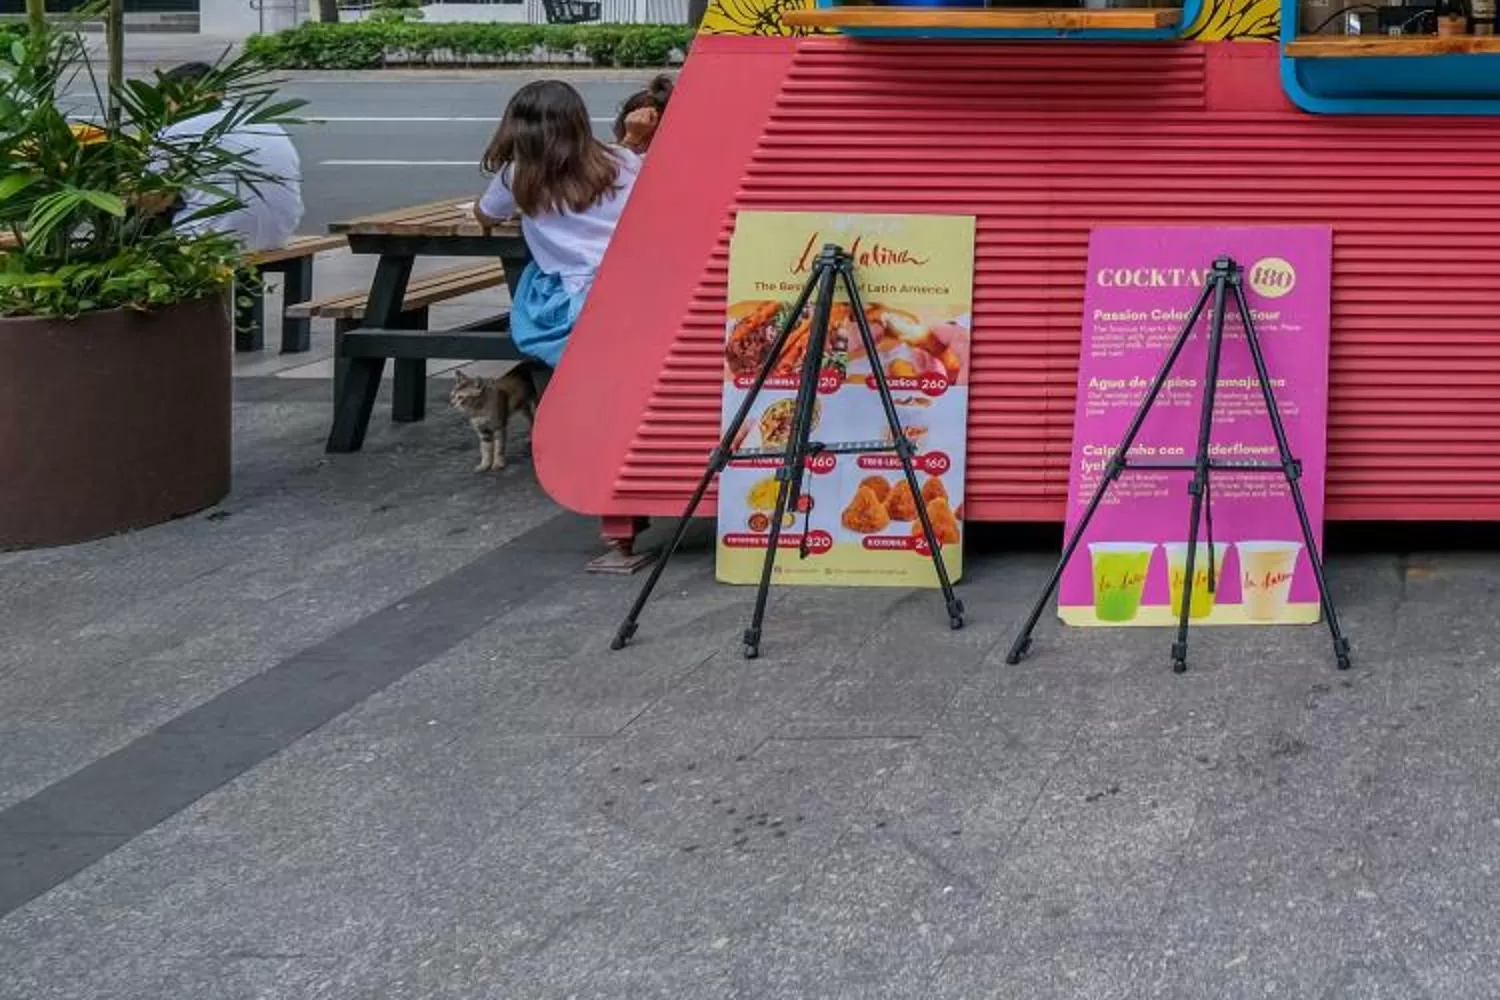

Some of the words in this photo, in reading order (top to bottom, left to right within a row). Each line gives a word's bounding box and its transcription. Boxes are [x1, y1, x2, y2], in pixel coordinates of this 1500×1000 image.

[1093, 309, 1147, 321] Passion
[921, 379, 947, 390] 260
[1088, 376, 1125, 390] Agua
[1129, 376, 1148, 388] de
